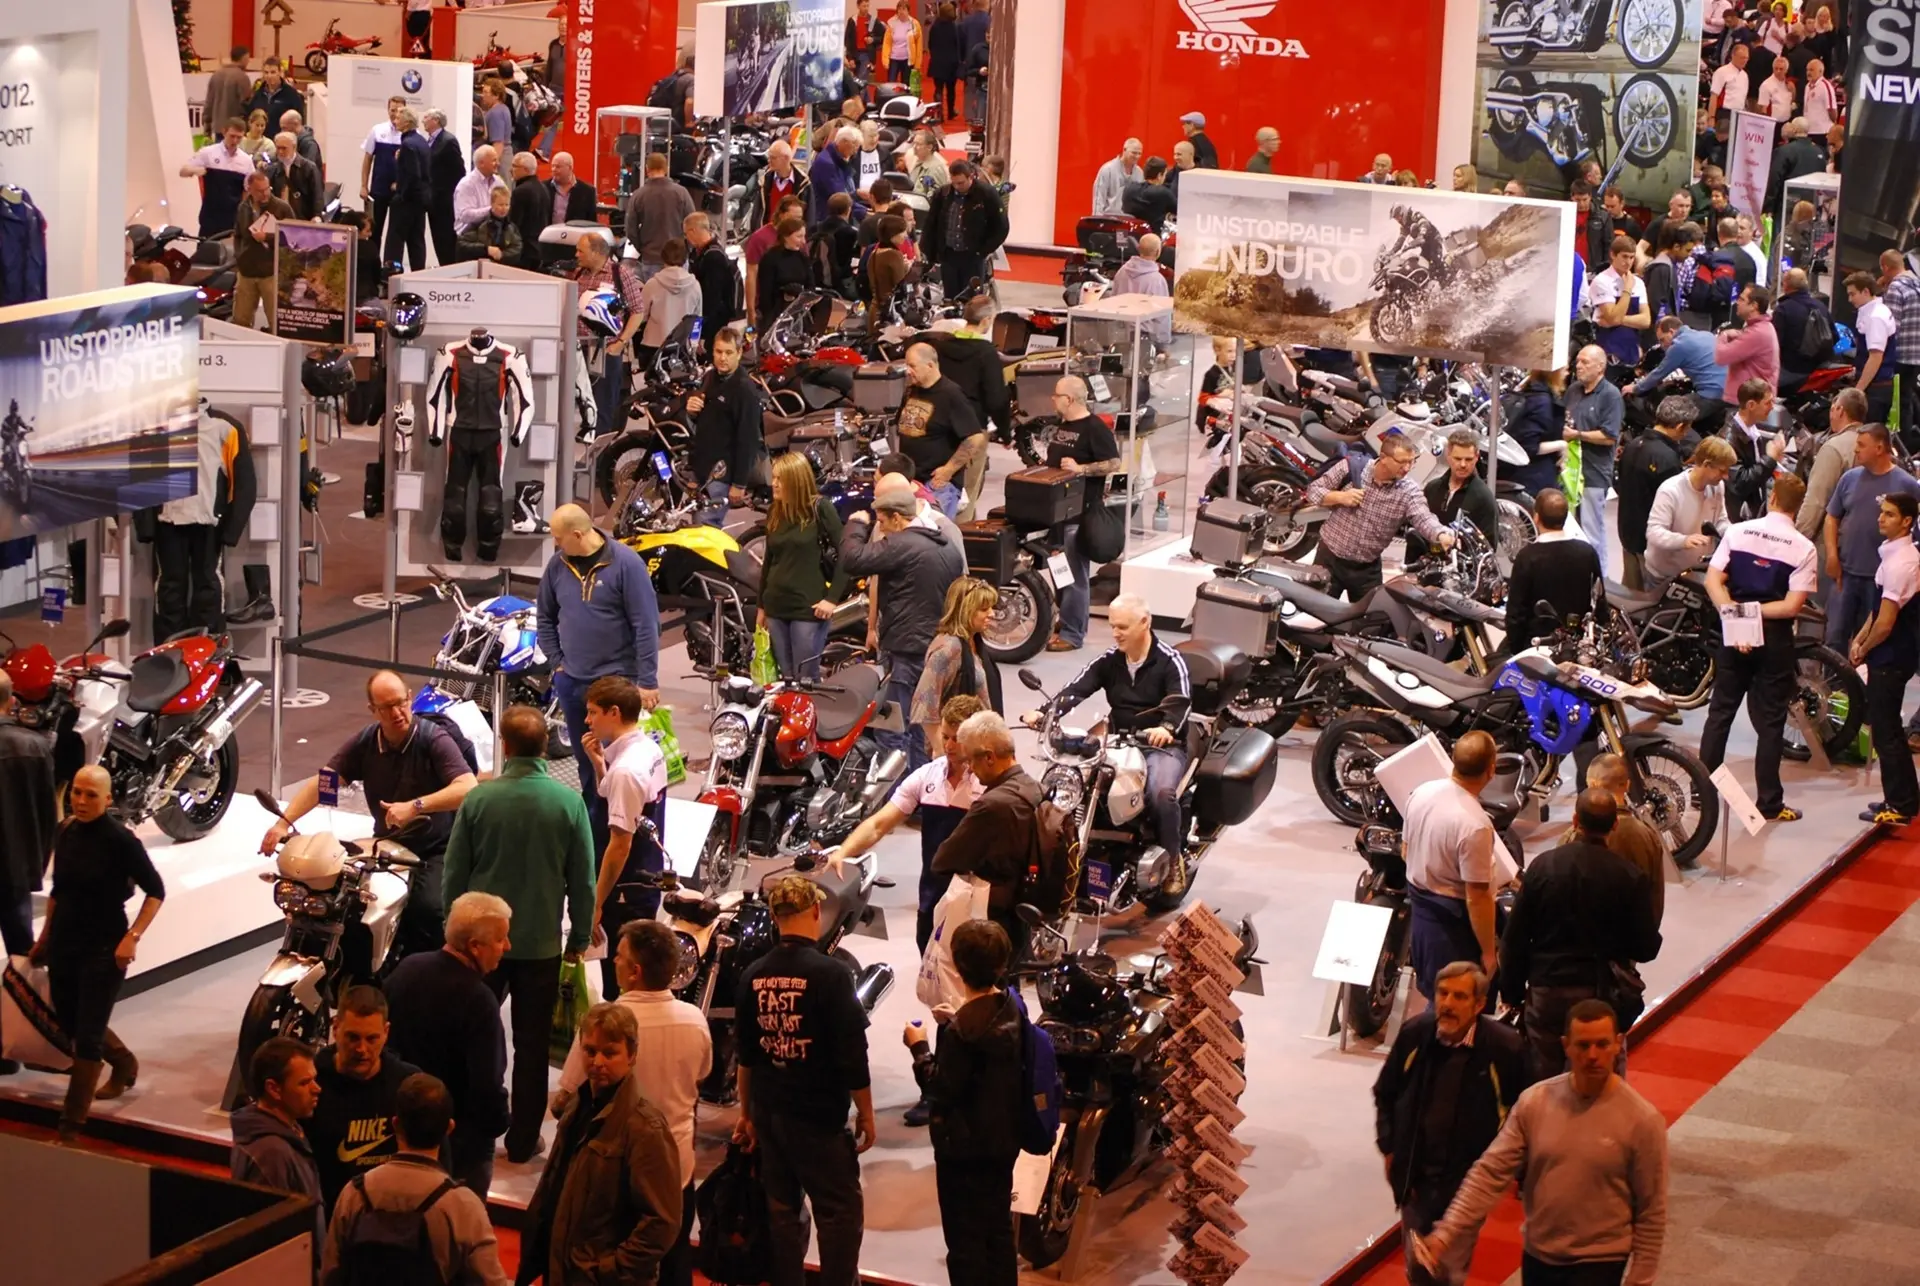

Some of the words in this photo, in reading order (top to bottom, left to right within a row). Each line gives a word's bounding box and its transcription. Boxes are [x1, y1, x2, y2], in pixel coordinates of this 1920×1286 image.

[786, 7, 840, 26] UNSTOPPABLE
[577, 29, 593, 44] &
[786, 24, 839, 57] TOURS
[1176, 31, 1310, 59] HONDA
[574, 47, 593, 136] SCOOTERS
[1744, 131, 1765, 144] WIN
[862, 163, 879, 174] CAT
[1195, 213, 1364, 248] UNSTOPPABLE
[1194, 237, 1364, 285] ENDURO
[428, 290, 461, 303] Sport
[464, 291, 475, 302] 2.
[40, 315, 183, 366] UNSTOPPABLE
[215, 355, 227, 366] 3.
[41, 343, 184, 404] ROADSTER
[1743, 529, 1761, 538] BMW
[1761, 532, 1793, 546] Motorrad
[1665, 582, 1702, 609] GS
[1498, 668, 1538, 698] GS
[1088, 865, 1102, 874] NEW
[757, 990, 803, 1013] FAST
[347, 1117, 388, 1142] NIKE
